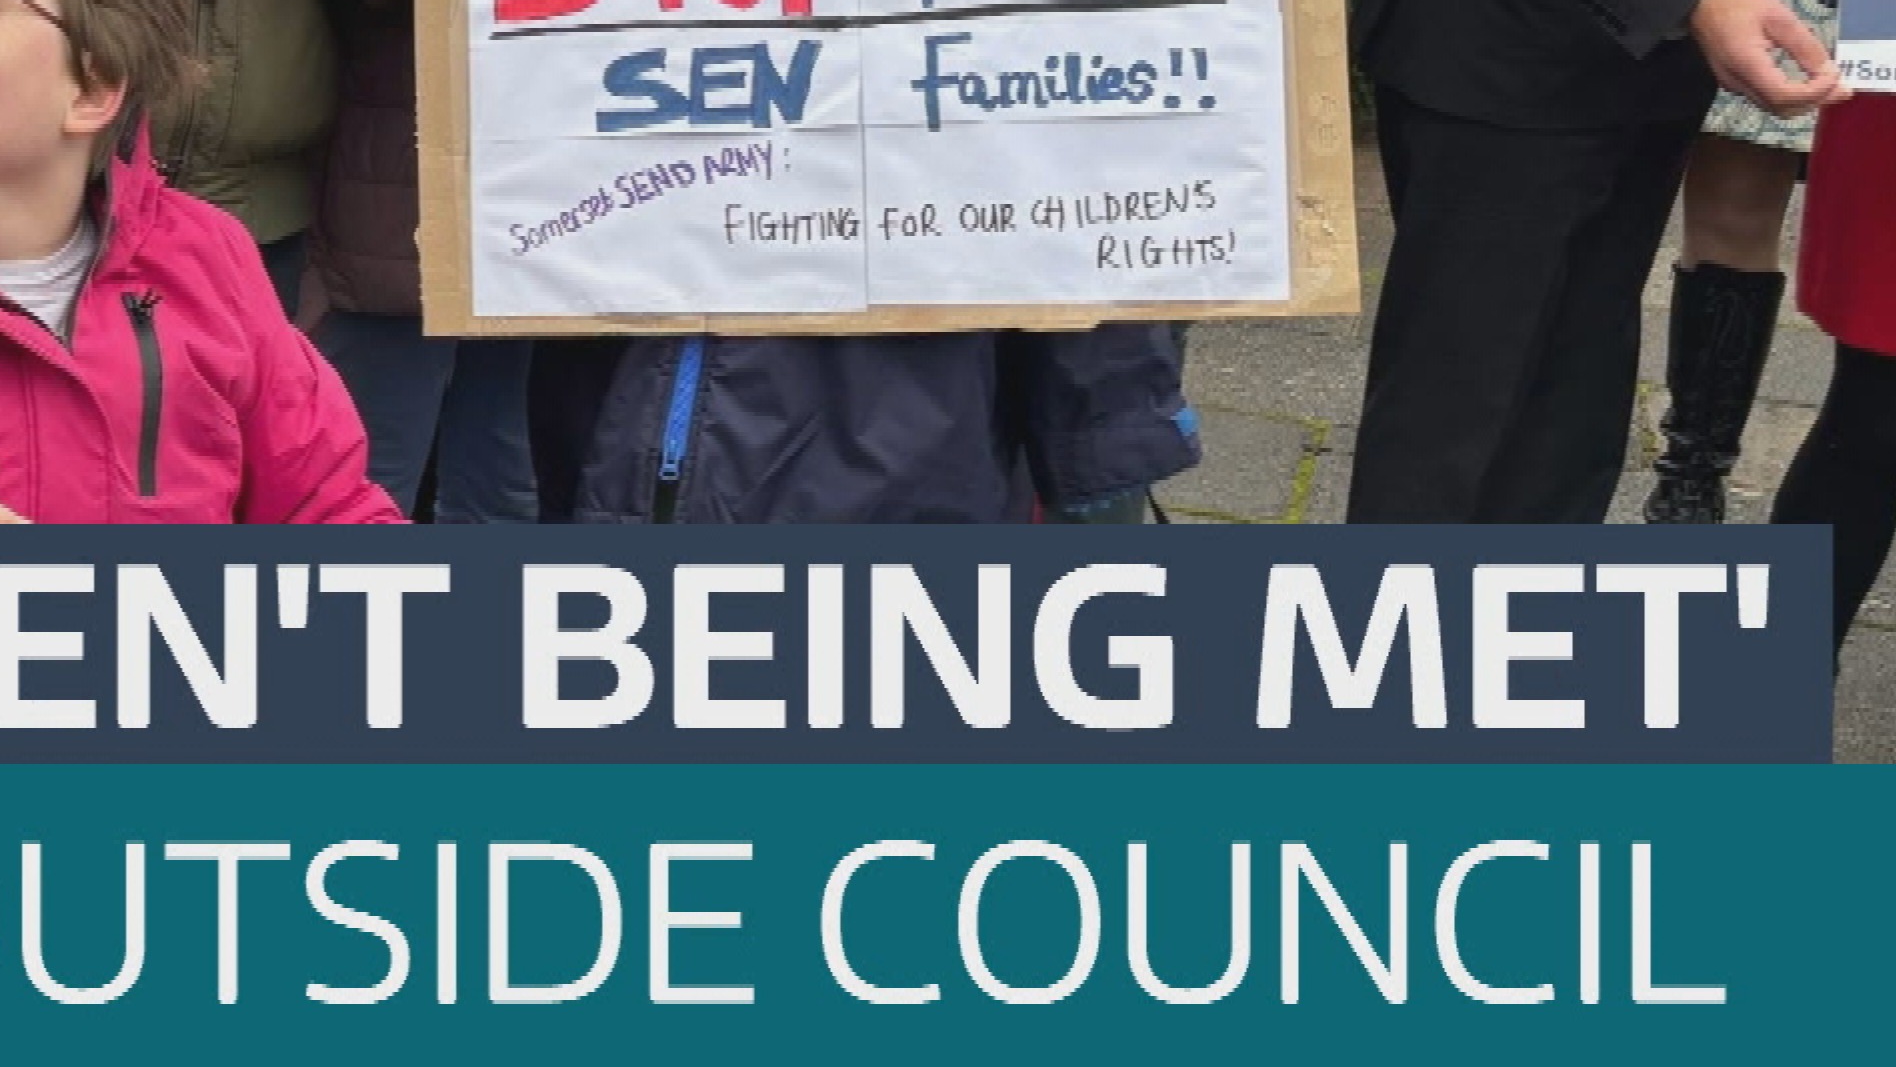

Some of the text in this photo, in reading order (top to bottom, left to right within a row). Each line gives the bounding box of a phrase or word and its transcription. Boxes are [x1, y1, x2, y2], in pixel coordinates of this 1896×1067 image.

[596, 38, 822, 133] SEN
[1838, 60, 1896, 81] #So
[613, 160, 697, 209] SEND
[723, 203, 861, 245] FIGHTING
[959, 202, 1016, 233] OUR
[1097, 228, 1236, 269] RIGHTS!
